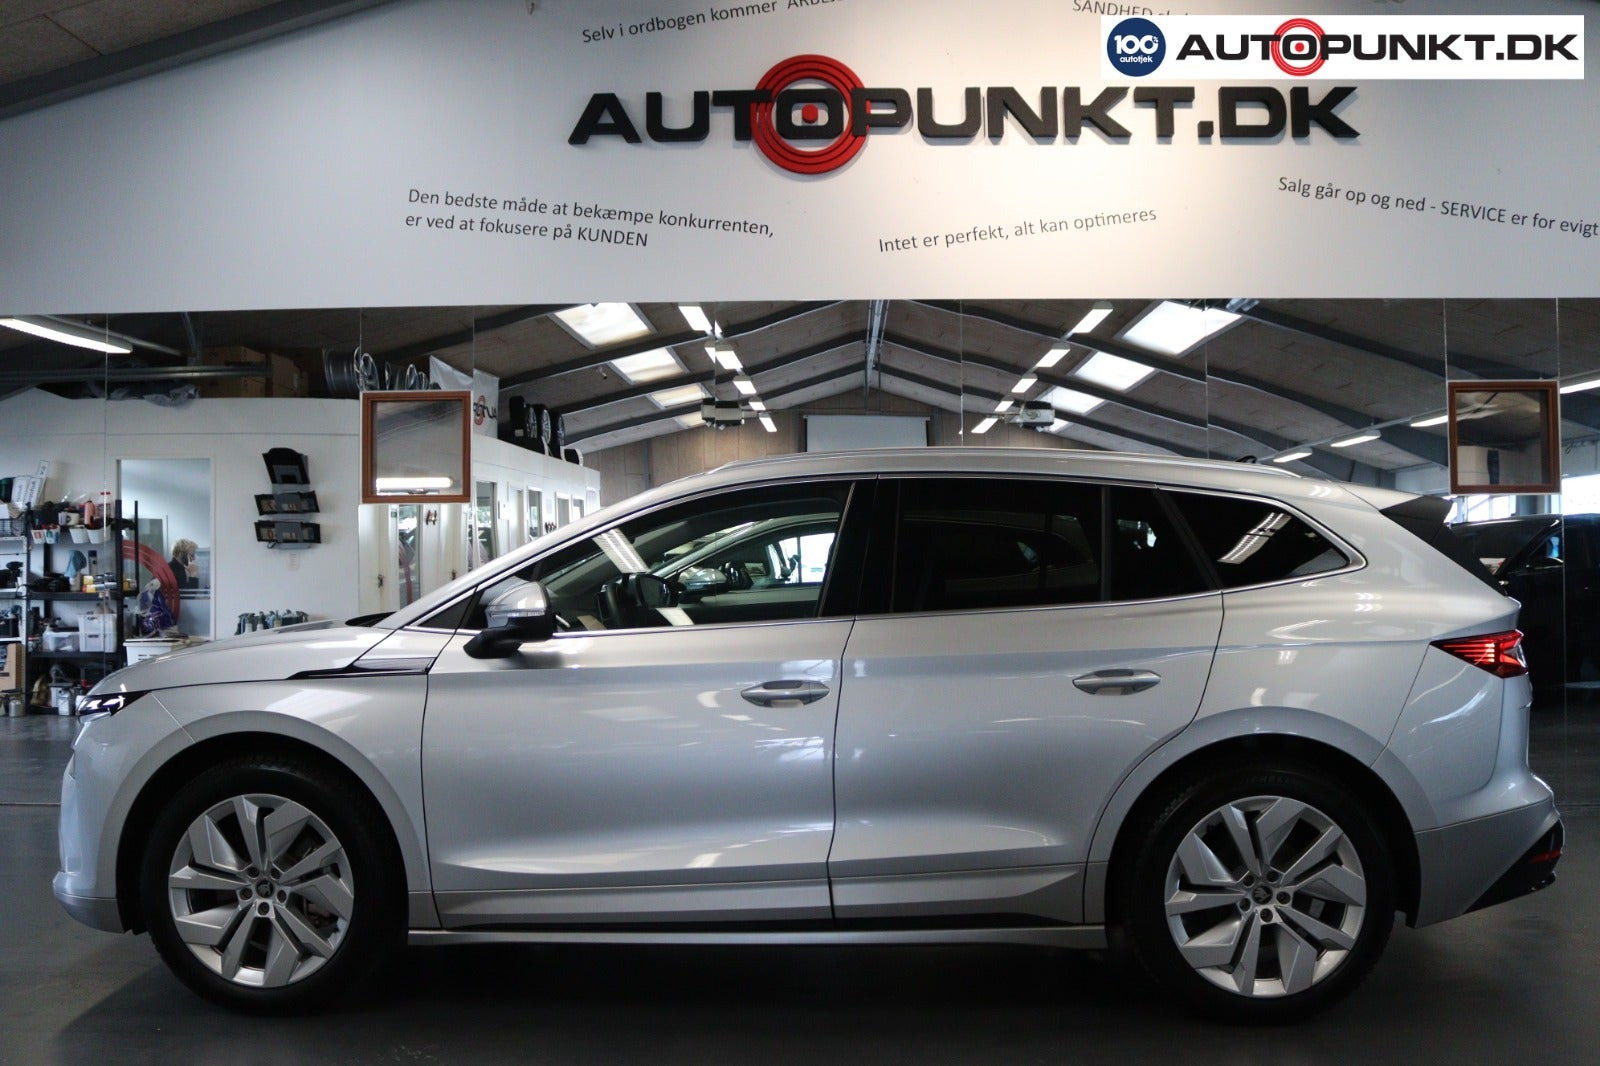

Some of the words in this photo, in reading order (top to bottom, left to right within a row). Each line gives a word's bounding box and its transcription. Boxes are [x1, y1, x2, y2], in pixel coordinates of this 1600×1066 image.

[582, 25, 615, 44] Selv
[619, 23, 624, 37] i
[628, 12, 706, 36] ordbogen
[710, 0, 778, 21] kommer
[567, 86, 1361, 145] AUTOPUNKT.DK
[408, 189, 440, 204] Den
[444, 191, 498, 210] bedste
[502, 197, 548, 214] måde
[552, 202, 568, 216] at
[573, 202, 654, 225] bekæmpe
[658, 210, 774, 238] konkurrenten,
[1278, 176, 1311, 198] Salg
[1315, 182, 1342, 199] går
[1345, 190, 1367, 206] op
[1371, 193, 1391, 210] og
[1395, 197, 1426, 211] ned
[1440, 200, 1507, 223] SERVICE
[1511, 213, 1528, 226] er
[1533, 212, 1556, 230] for
[1559, 219, 1599, 238] evigt
[405, 215, 422, 227] er
[426, 215, 455, 230] ved
[459, 217, 475, 232] at
[480, 217, 548, 237] fokusere
[552, 224, 573, 241] på
[577, 226, 649, 247] KUNDEN
[879, 236, 918, 252] Intet
[923, 233, 940, 247] er
[944, 225, 1009, 248] perfekt,
[1014, 221, 1035, 237] alt
[1040, 218, 1069, 234] kan
[1073, 209, 1157, 231] optimeres
